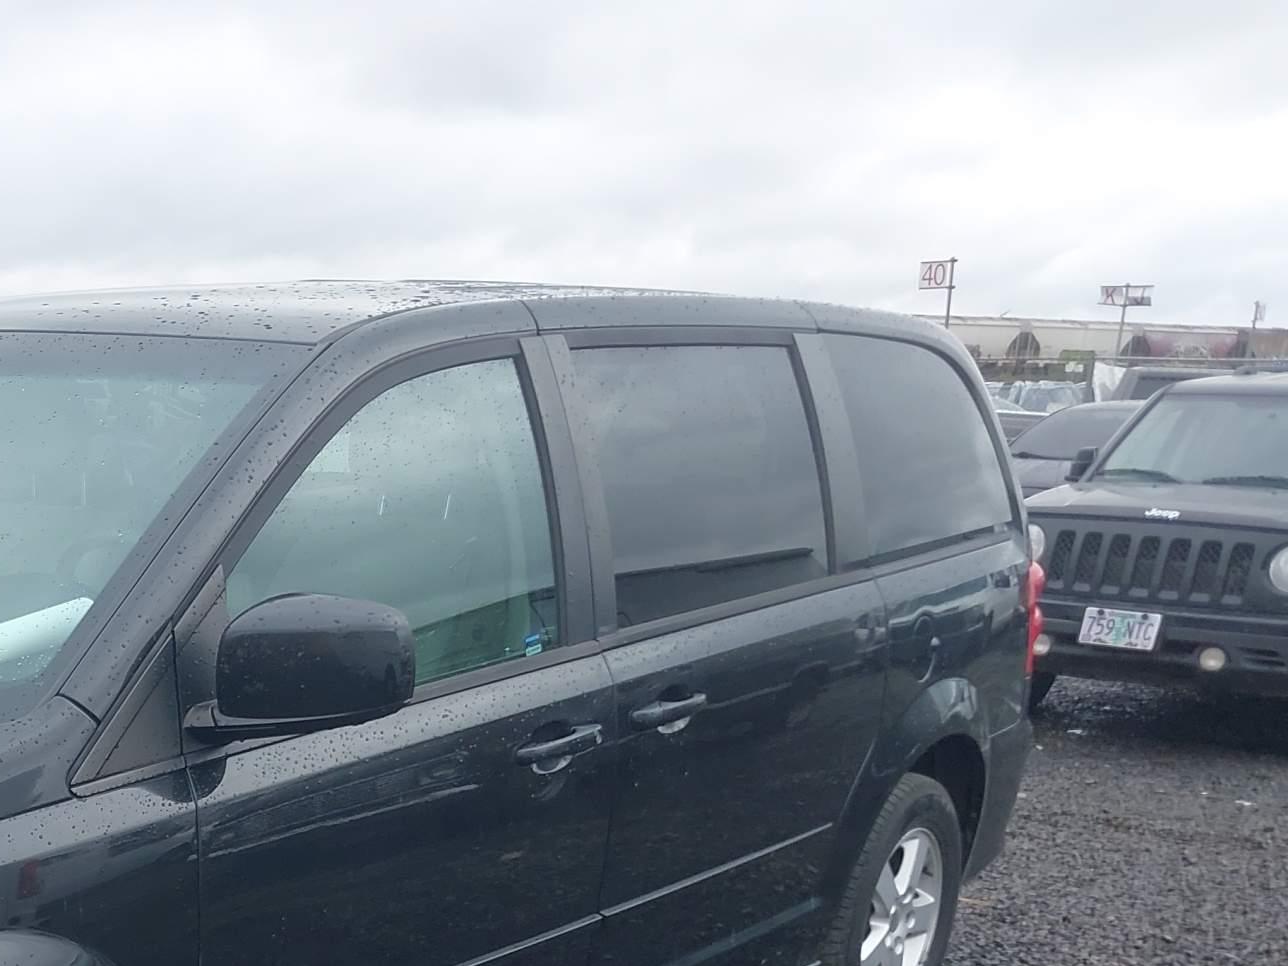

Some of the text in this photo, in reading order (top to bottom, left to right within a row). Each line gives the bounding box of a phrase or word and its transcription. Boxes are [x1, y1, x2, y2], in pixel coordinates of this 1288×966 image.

[922, 263, 946, 286] 40
[1143, 508, 1180, 520] Jeep
[1087, 615, 1154, 641] 759 NTC
